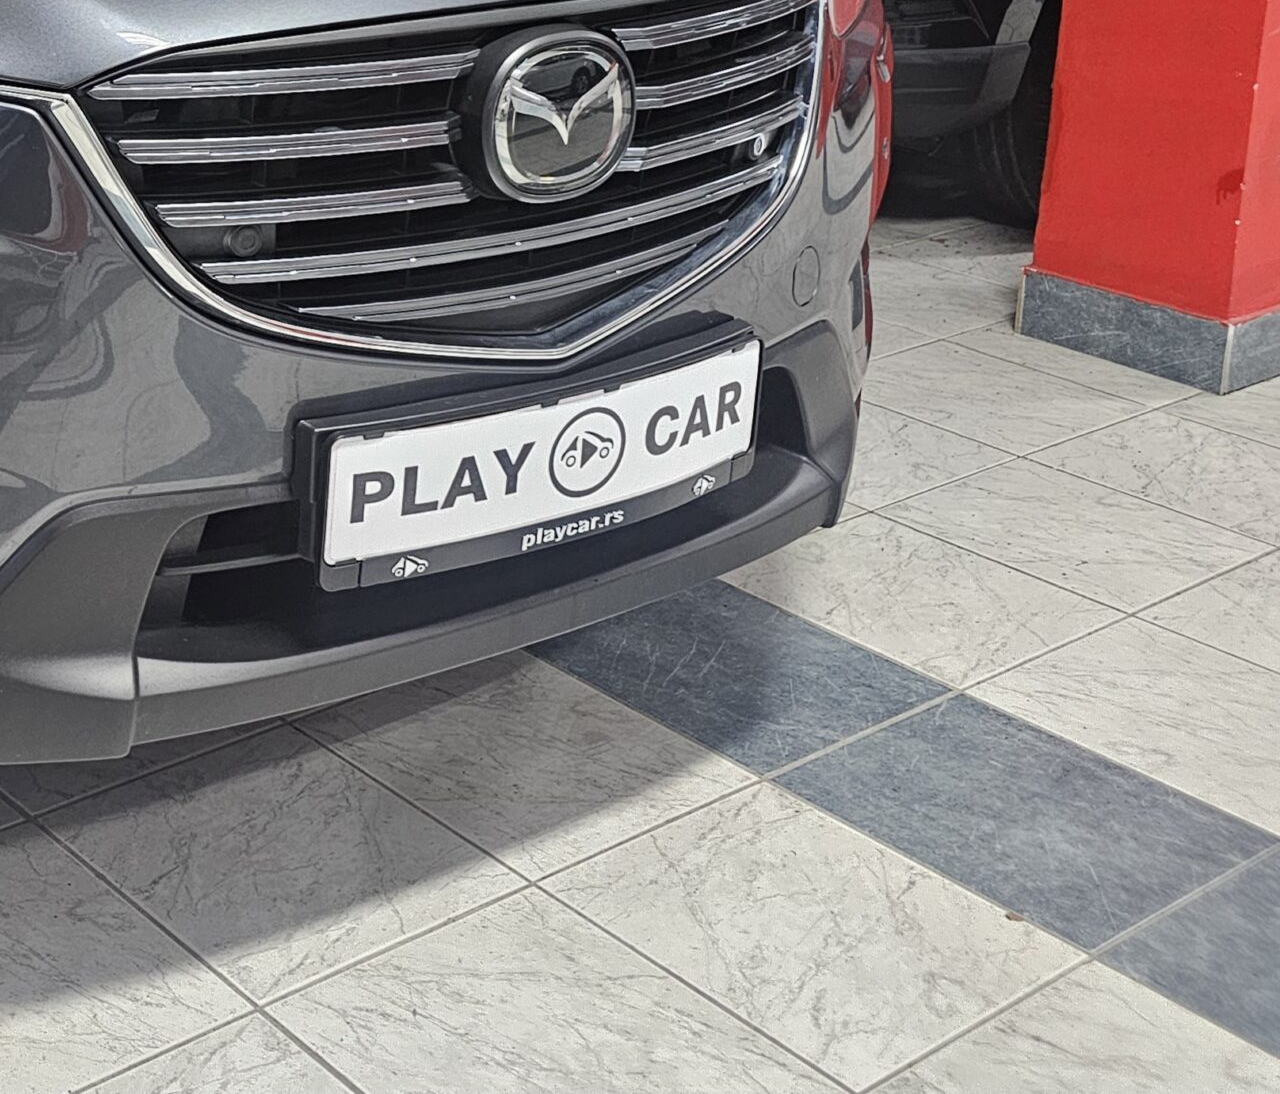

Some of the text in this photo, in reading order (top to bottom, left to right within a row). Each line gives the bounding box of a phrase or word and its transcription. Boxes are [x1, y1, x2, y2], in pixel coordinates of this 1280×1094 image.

[349, 381, 743, 524] PLAY CAR
[521, 509, 625, 551] playcar.rs
